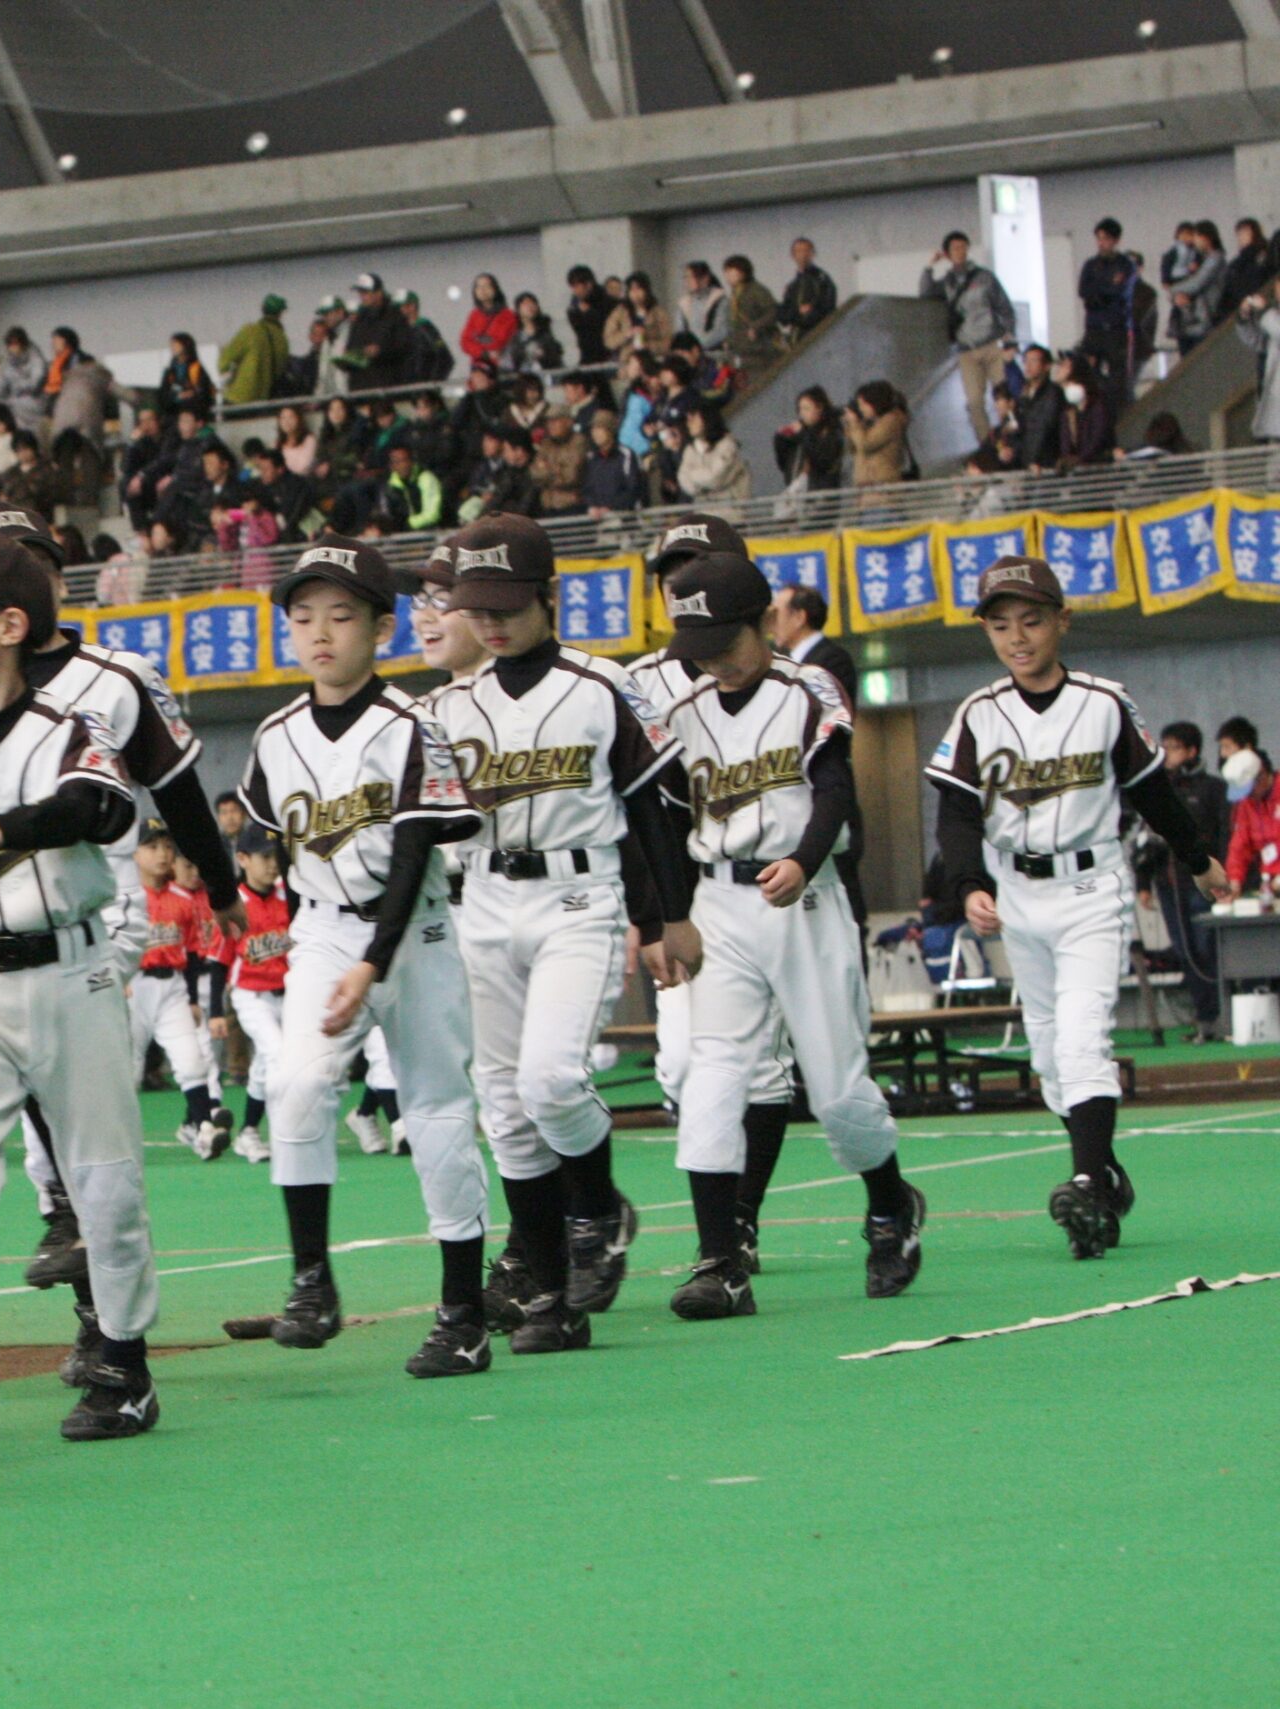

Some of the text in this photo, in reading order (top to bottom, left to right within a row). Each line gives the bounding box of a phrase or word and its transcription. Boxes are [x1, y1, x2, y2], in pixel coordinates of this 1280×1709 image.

[567, 574, 626, 605] 交通
[190, 610, 250, 640] 交通
[567, 606, 626, 636] 安全
[191, 641, 251, 670] 安全
